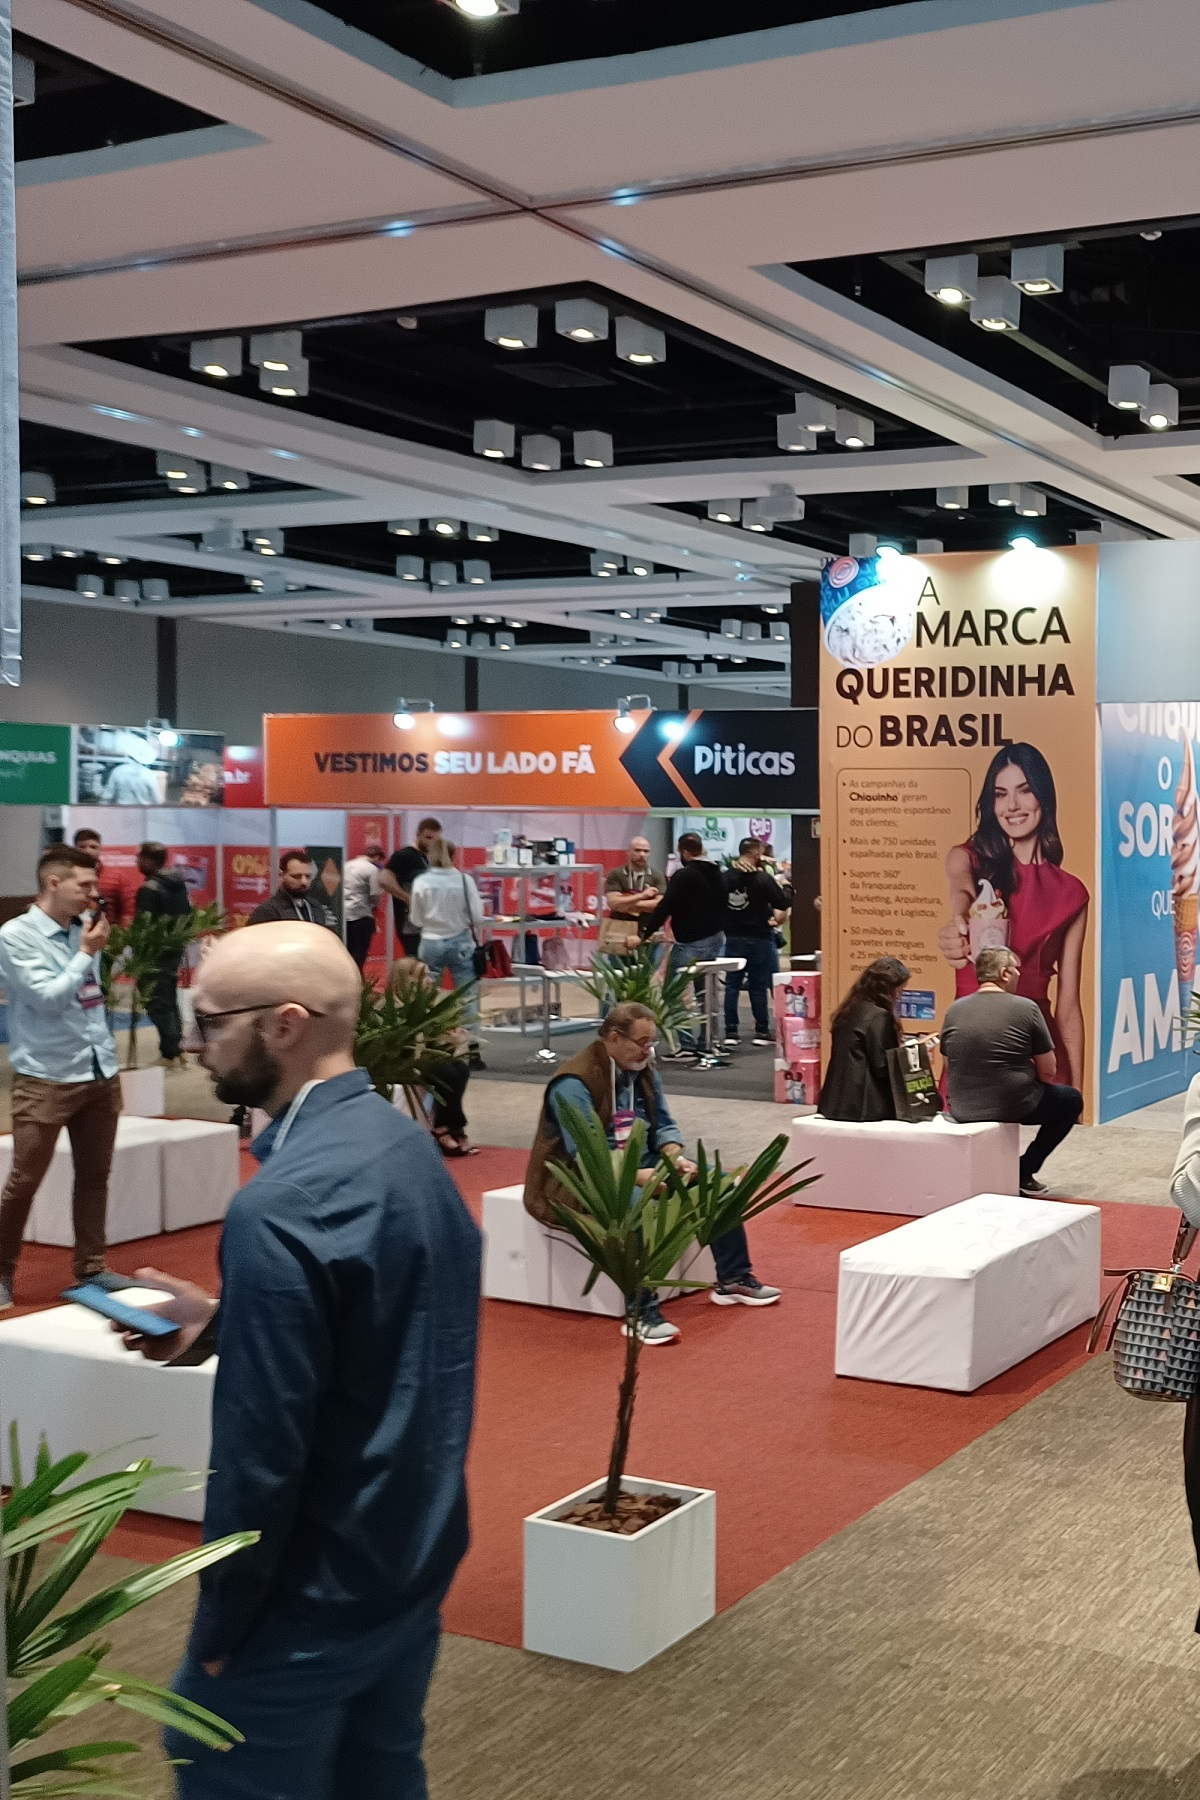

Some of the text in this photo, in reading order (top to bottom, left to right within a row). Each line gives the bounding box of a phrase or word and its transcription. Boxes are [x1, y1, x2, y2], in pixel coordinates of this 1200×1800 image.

[917, 576, 941, 606] A
[915, 606, 1071, 648] MARCA
[835, 663, 1075, 705] QUERIDINHA
[836, 713, 1014, 748] DO BRASIL
[0, 750, 57, 764] NQUIAS
[314, 744, 596, 774] VESTIMOS SEU LADO FÃ
[694, 742, 796, 776] Piticas
[1157, 756, 1173, 790] O
[850, 780, 918, 790] As campanhas da
[849, 792, 927, 803] Chiquinho geram
[850, 806, 951, 816] engajamento espontâneo
[850, 819, 864, 827] dos
[850, 837, 937, 847] Mais de 750 unidades
[850, 850, 894, 860] espalhadas
[895, 850, 913, 860] pelo
[850, 870, 881, 879] Suporte
[850, 882, 860, 890] da
[1151, 890, 1176, 921] QUE
[850, 906, 892, 917] Tecnologia
[862, 927, 893, 936] milhões
[895, 928, 905, 936] de
[850, 939, 925, 949] sorvetes entregues
